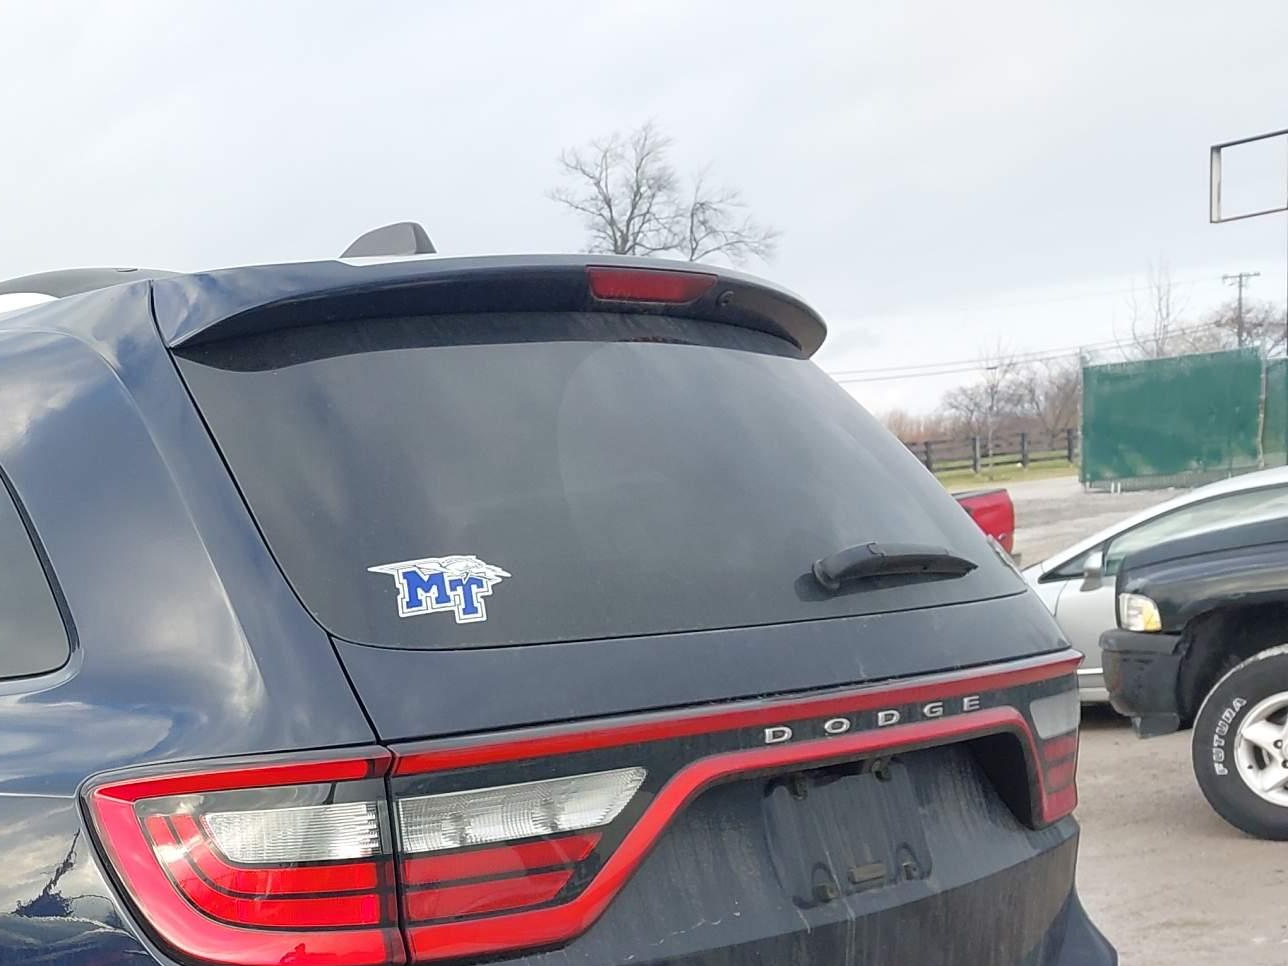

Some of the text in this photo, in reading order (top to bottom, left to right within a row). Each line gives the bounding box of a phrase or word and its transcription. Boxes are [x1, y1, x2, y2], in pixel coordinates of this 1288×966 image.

[399, 568, 486, 618] MT
[764, 695, 981, 745] DODGE
[1212, 696, 1248, 777] FUTURA
